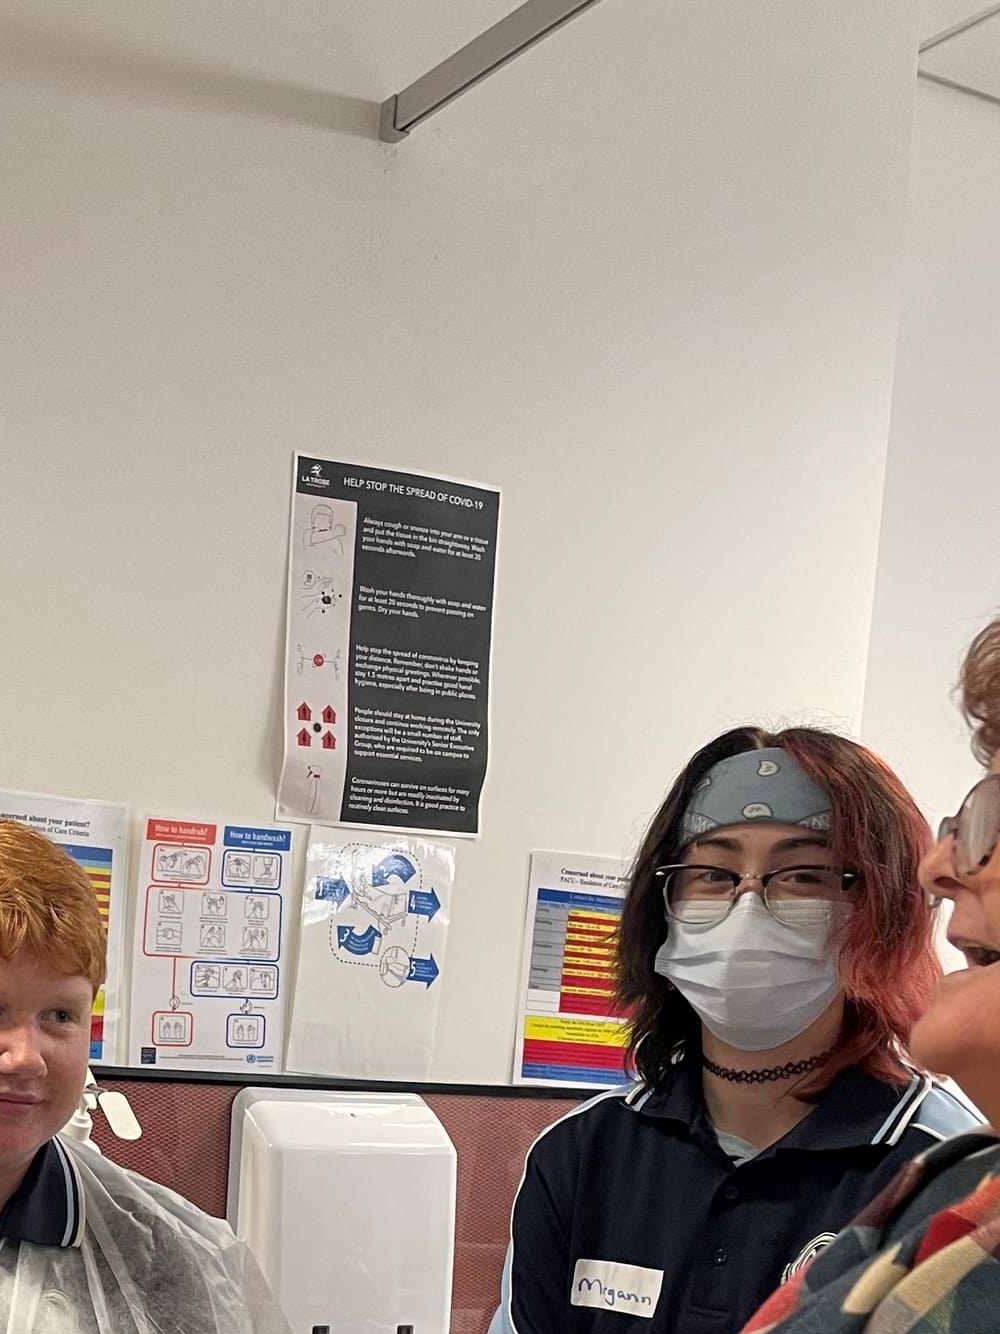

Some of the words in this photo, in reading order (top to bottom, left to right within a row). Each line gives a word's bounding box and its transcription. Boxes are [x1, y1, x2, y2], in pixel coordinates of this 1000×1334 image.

[343, 477, 365, 488] HELP
[366, 480, 388, 491] STOP
[389, 484, 404, 494] THE
[406, 486, 436, 499] SPREAD
[437, 493, 449, 502] OF
[449, 495, 484, 509] COVID-19
[356, 643, 369, 654] Help
[383, 647, 391, 655] the
[450, 656, 456, 665] by
[368, 670, 376, 678] 1.5
[393, 710, 404, 720] stay
[404, 711, 410, 719] at
[411, 712, 426, 720] home
[155, 824, 169, 833] How
[171, 825, 178, 833] to
[230, 831, 244, 839] How
[245, 832, 251, 840] to
[252, 832, 286, 843] handwash?
[561, 868, 589, 878] Concerned
[560, 876, 575, 884] PACU
[319, 880, 324, 896] 1
[410, 894, 416, 911] 4
[340, 928, 350, 942] 3
[410, 961, 416, 977] 5
